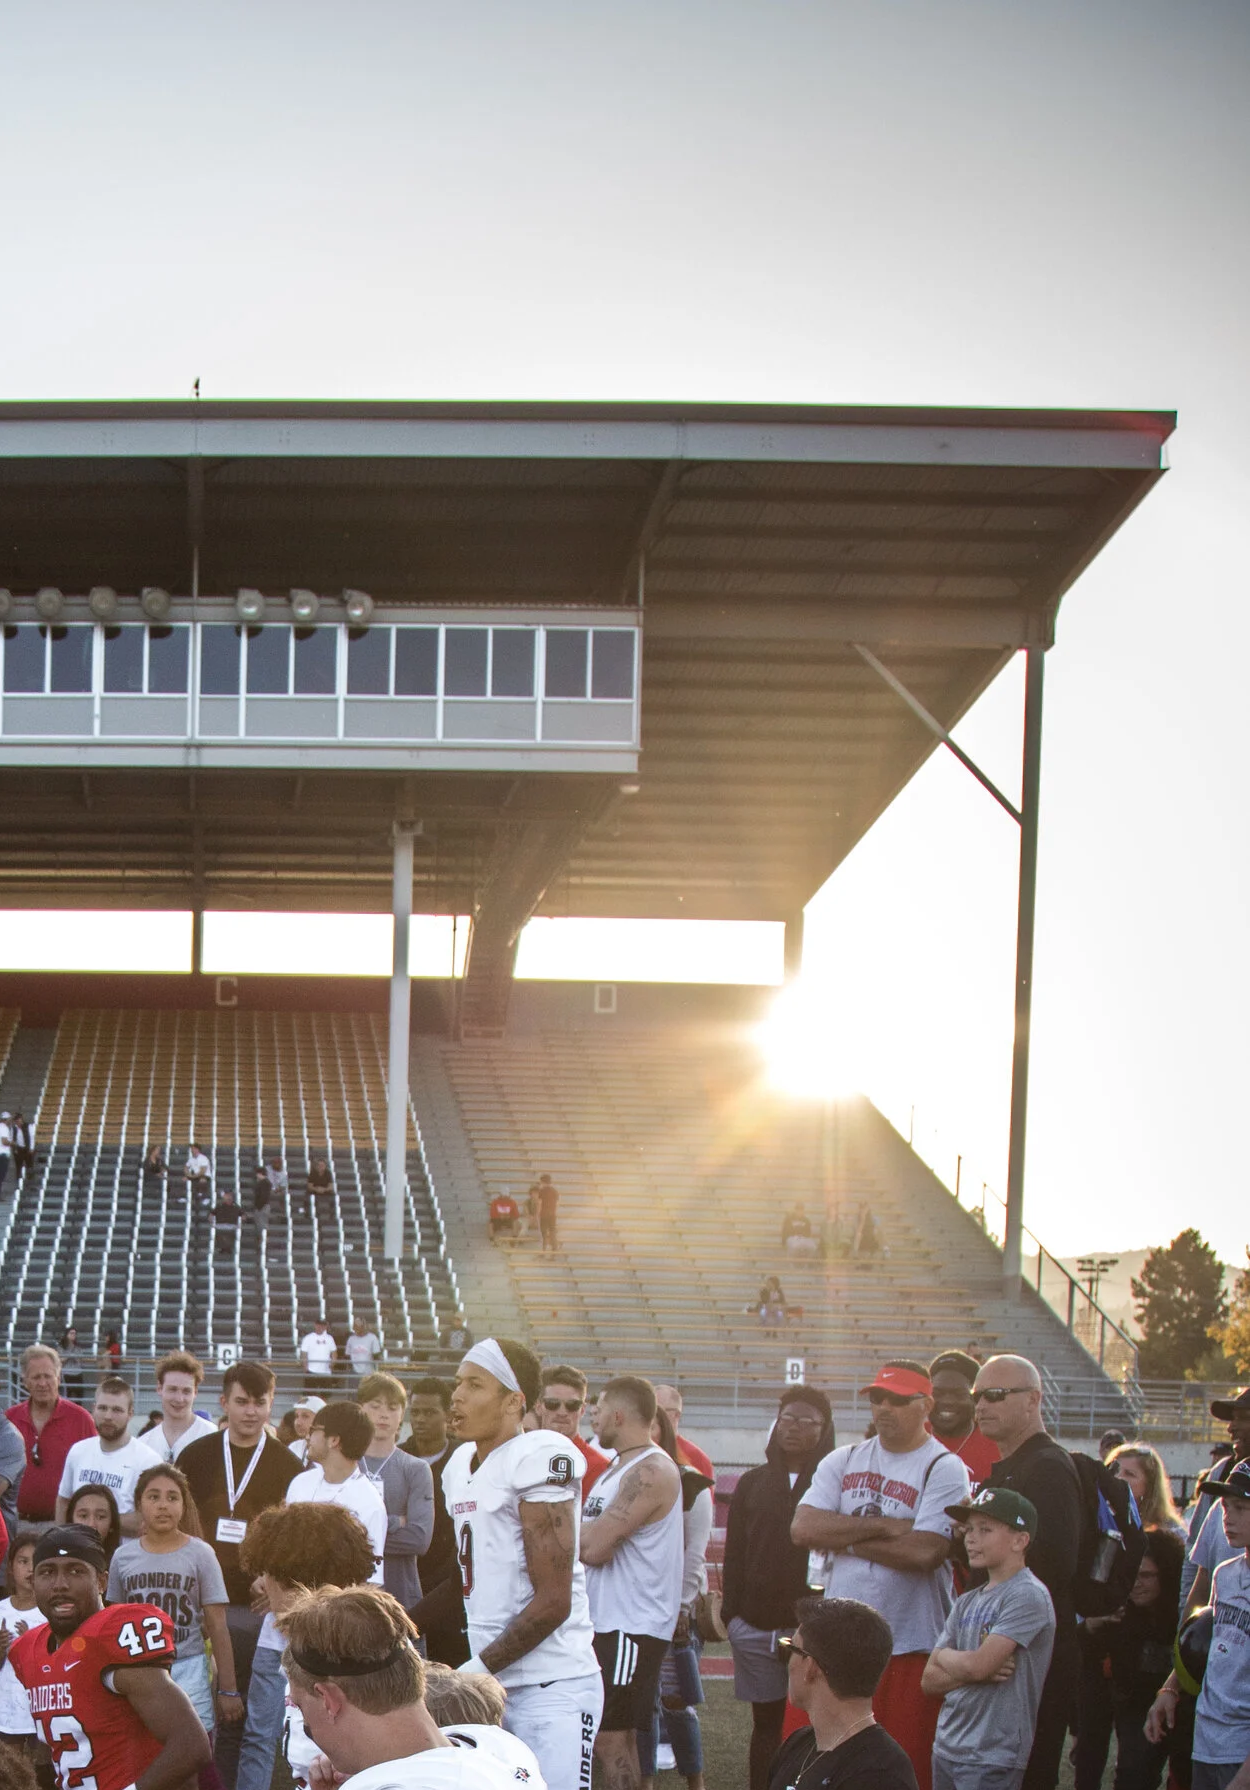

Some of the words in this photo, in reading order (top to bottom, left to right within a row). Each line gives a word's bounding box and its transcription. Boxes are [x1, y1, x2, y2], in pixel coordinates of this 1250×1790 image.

[216, 976, 238, 1006] C
[222, 1349, 232, 1366] C
[790, 1362, 800, 1380] D
[546, 1453, 575, 1487] 9
[126, 1571, 183, 1591] WONDER
[117, 1615, 167, 1657] 42
[27, 1682, 73, 1713] RAIDERS
